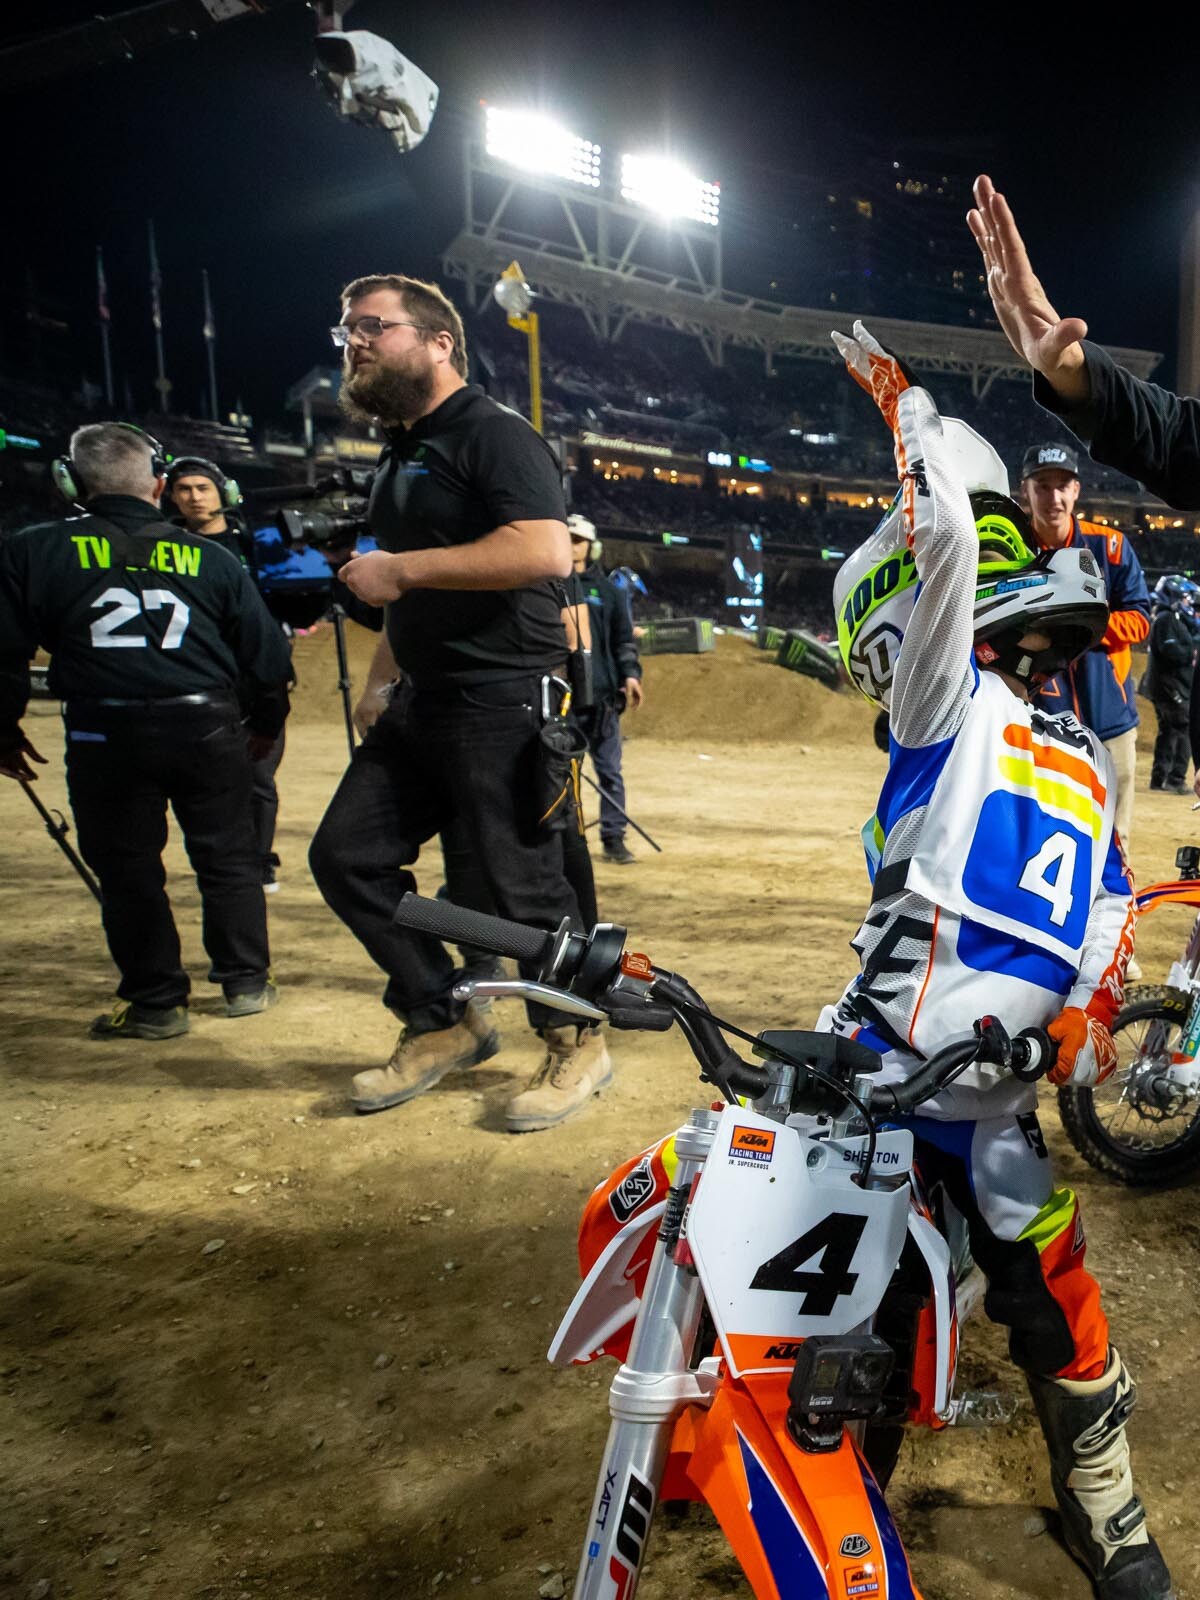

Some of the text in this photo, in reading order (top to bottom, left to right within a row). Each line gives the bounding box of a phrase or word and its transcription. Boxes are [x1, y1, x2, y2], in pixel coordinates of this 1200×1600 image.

[70, 536, 111, 569] TV
[90, 587, 190, 649] 27
[1018, 830, 1078, 928] 4
[730, 1148, 771, 1161] RACING TEAM
[738, 1134, 769, 1147] KTM
[843, 1150, 899, 1164] SHETON
[737, 1160, 769, 1170] SUPERCROSS
[748, 1212, 869, 1316] 4
[596, 1469, 618, 1531] XACT
